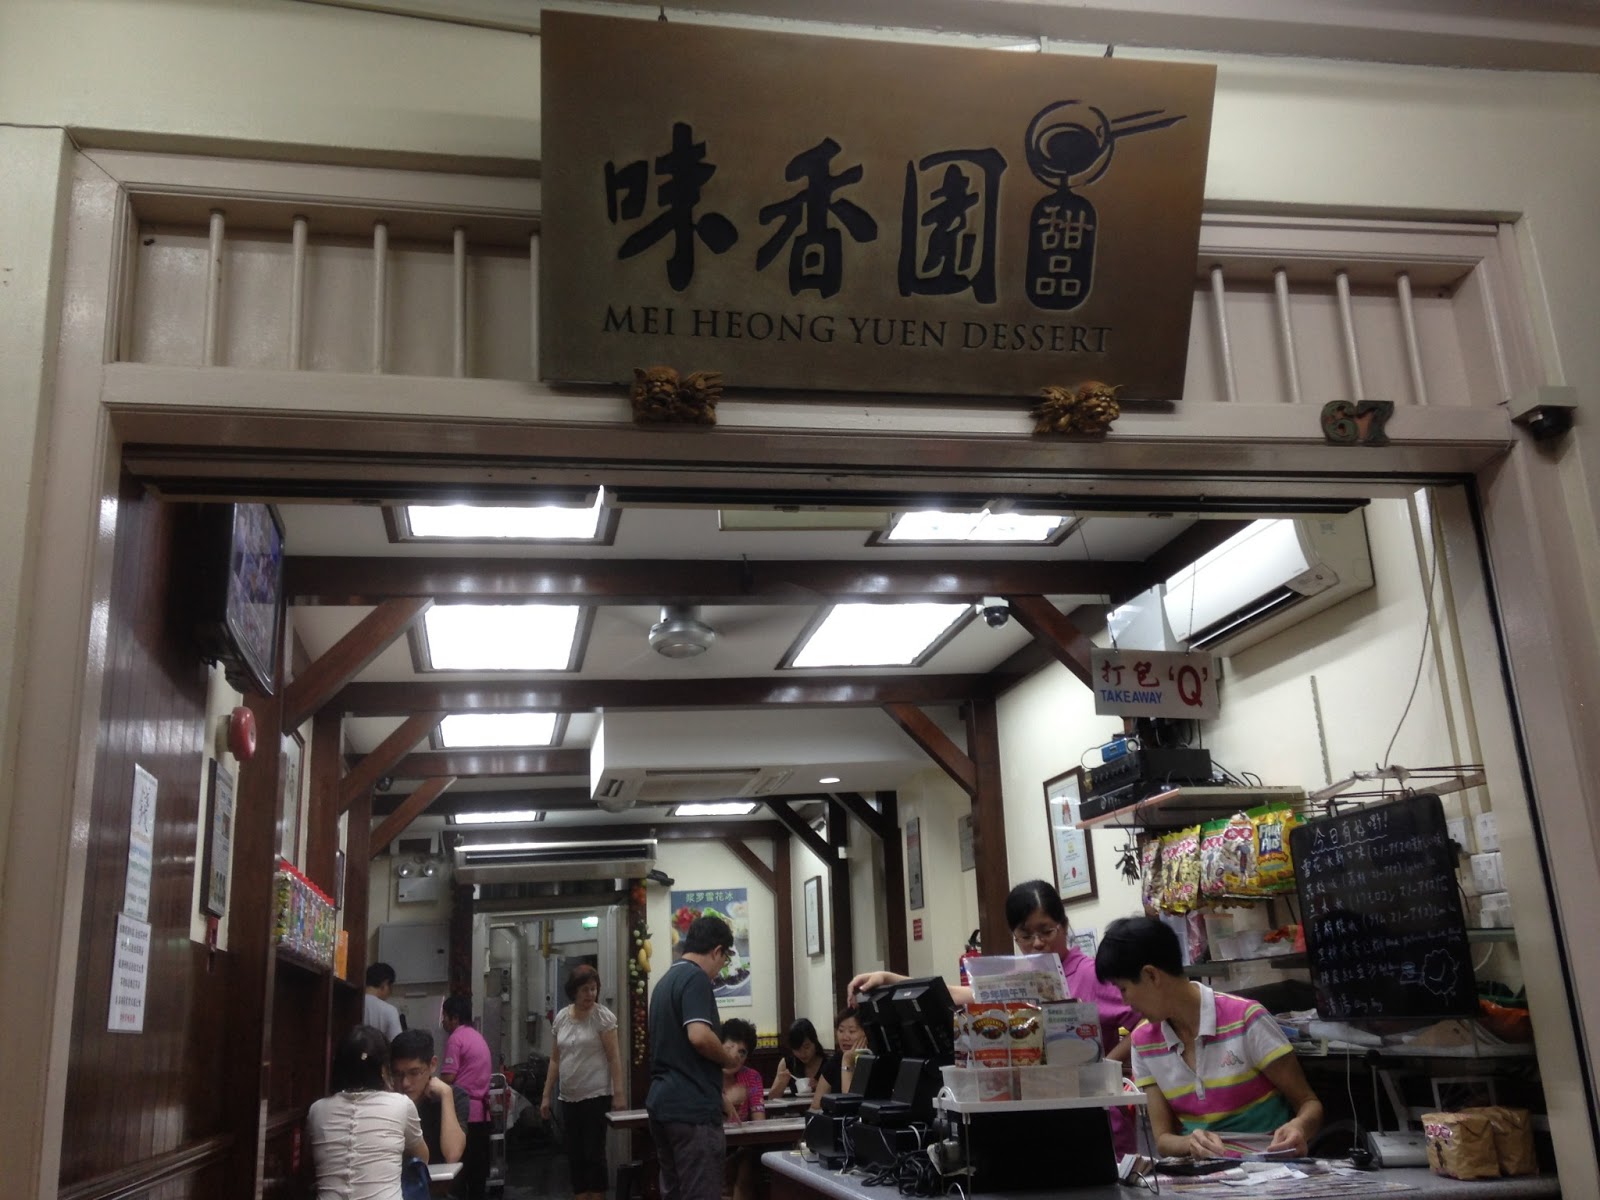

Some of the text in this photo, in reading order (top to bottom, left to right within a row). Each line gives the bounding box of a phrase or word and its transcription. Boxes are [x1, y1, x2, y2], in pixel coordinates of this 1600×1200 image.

[1035, 204, 1093, 298] 甜品
[603, 304, 1112, 354] MEI HEONG YUEN DESSERT
[1321, 400, 1394, 447] 67
[1100, 689, 1163, 704] TAKEAWAY
